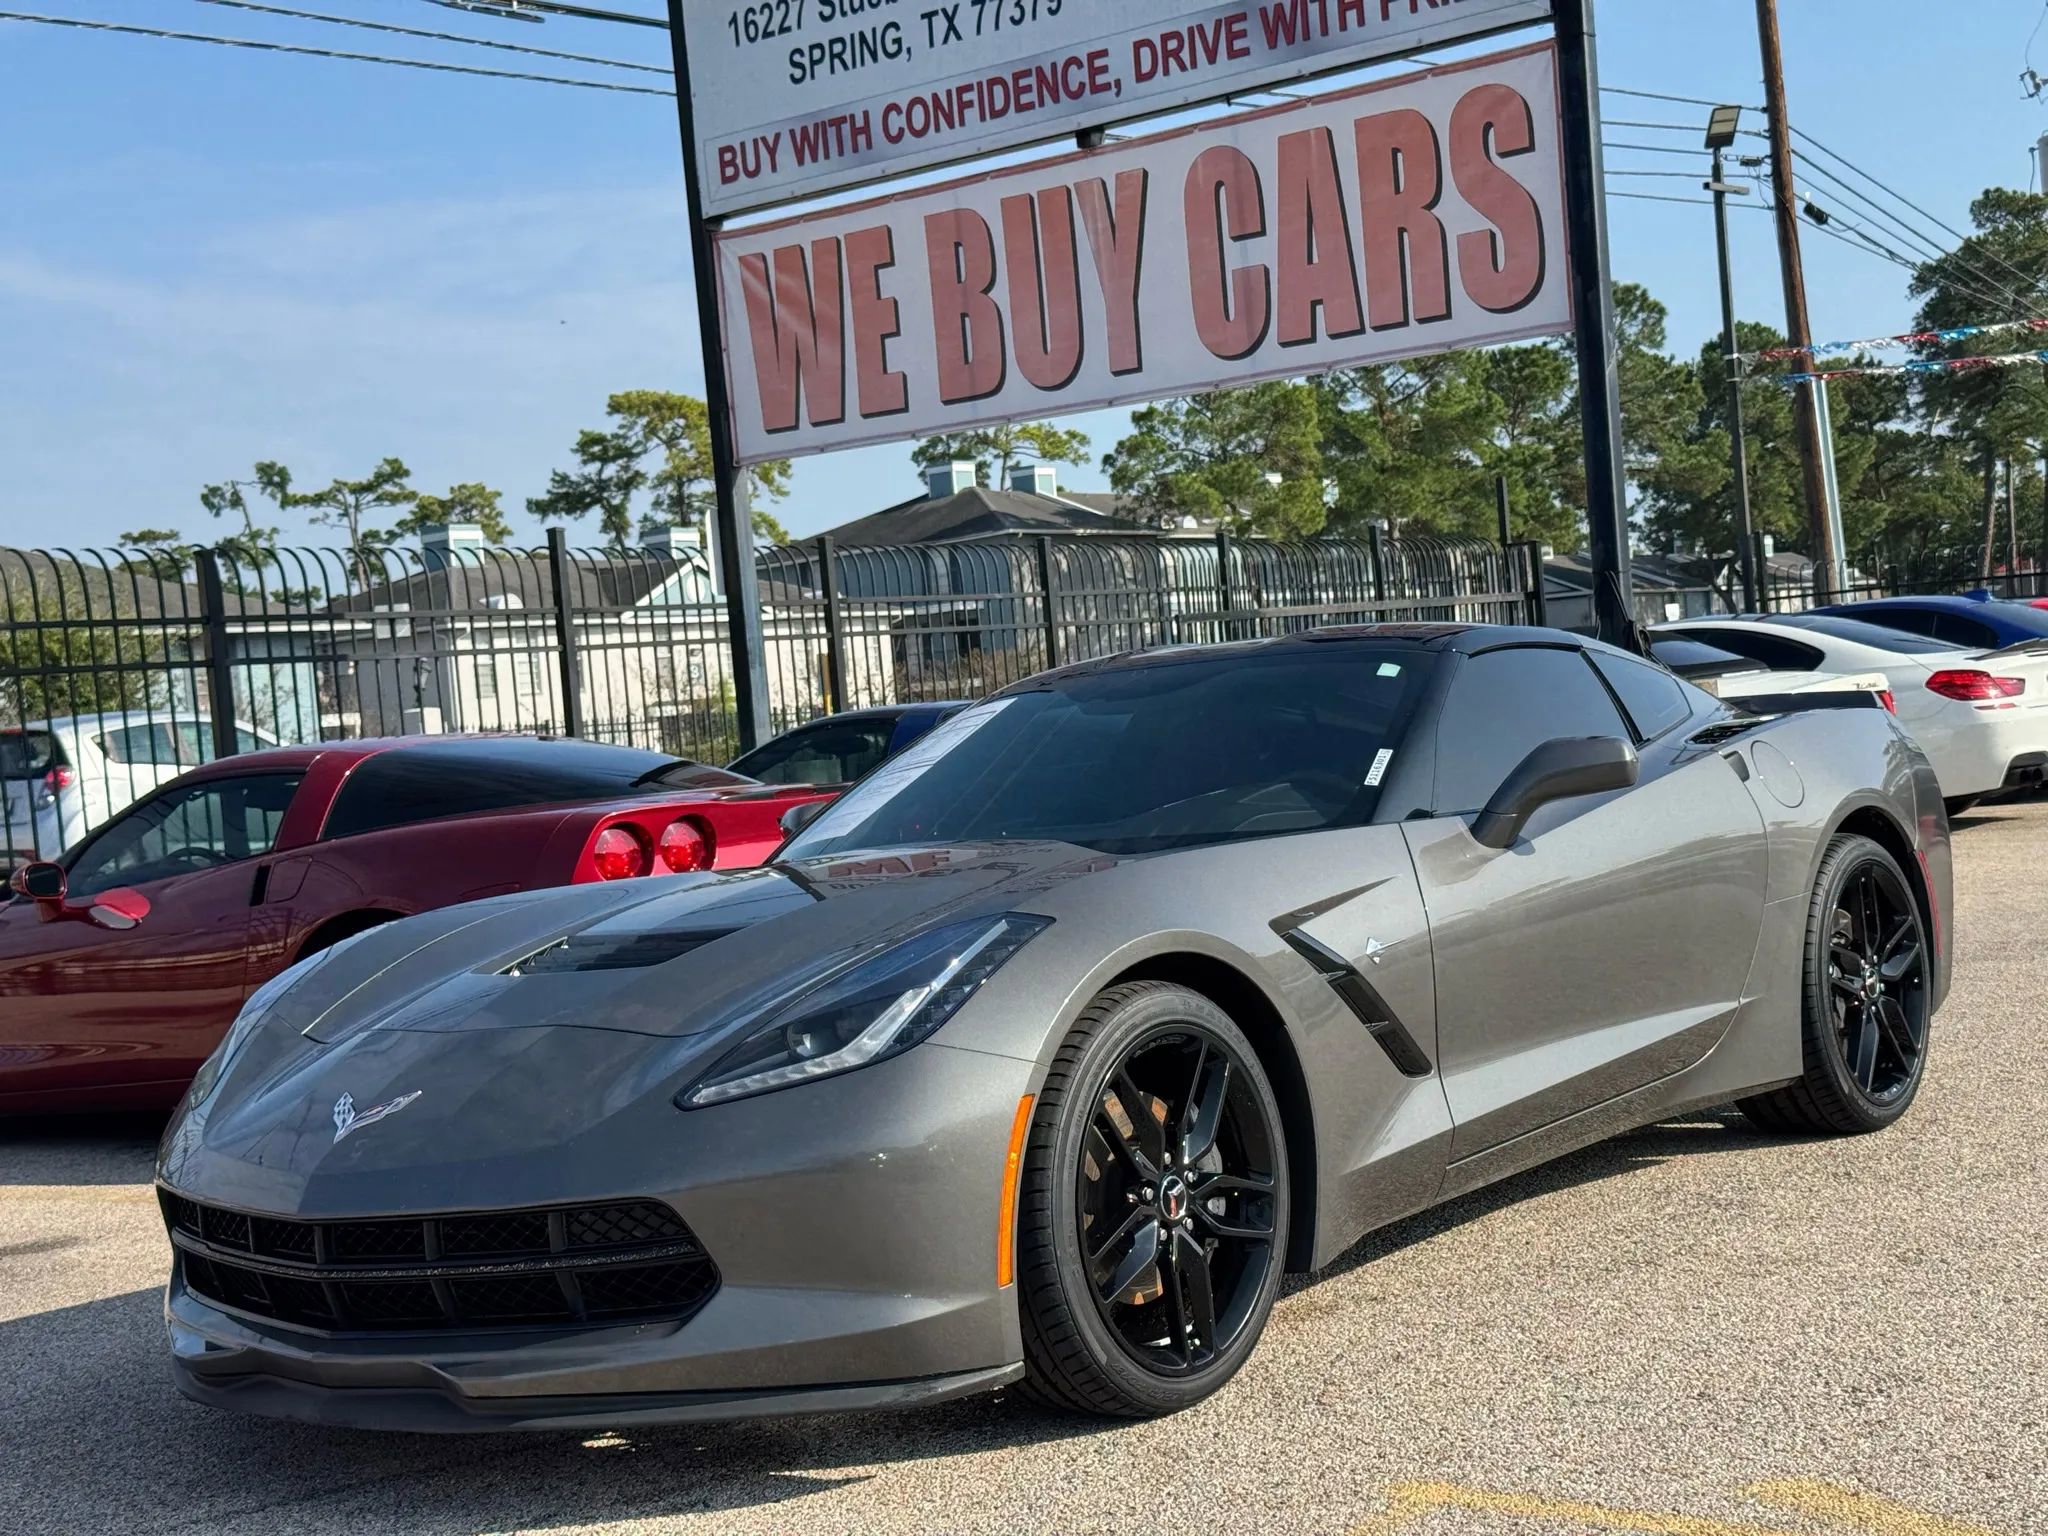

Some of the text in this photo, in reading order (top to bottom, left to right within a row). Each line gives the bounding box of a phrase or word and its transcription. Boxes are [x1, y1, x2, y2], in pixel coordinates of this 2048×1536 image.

[728, 0, 899, 47] 16227 Stu
[789, 21, 912, 84] SPRING,
[920, 3, 963, 48] TX
[718, 0, 1366, 185] BUY WITH CONFIDENCE, DRIVE WITH
[739, 83, 1545, 434] WE BUY CARS
